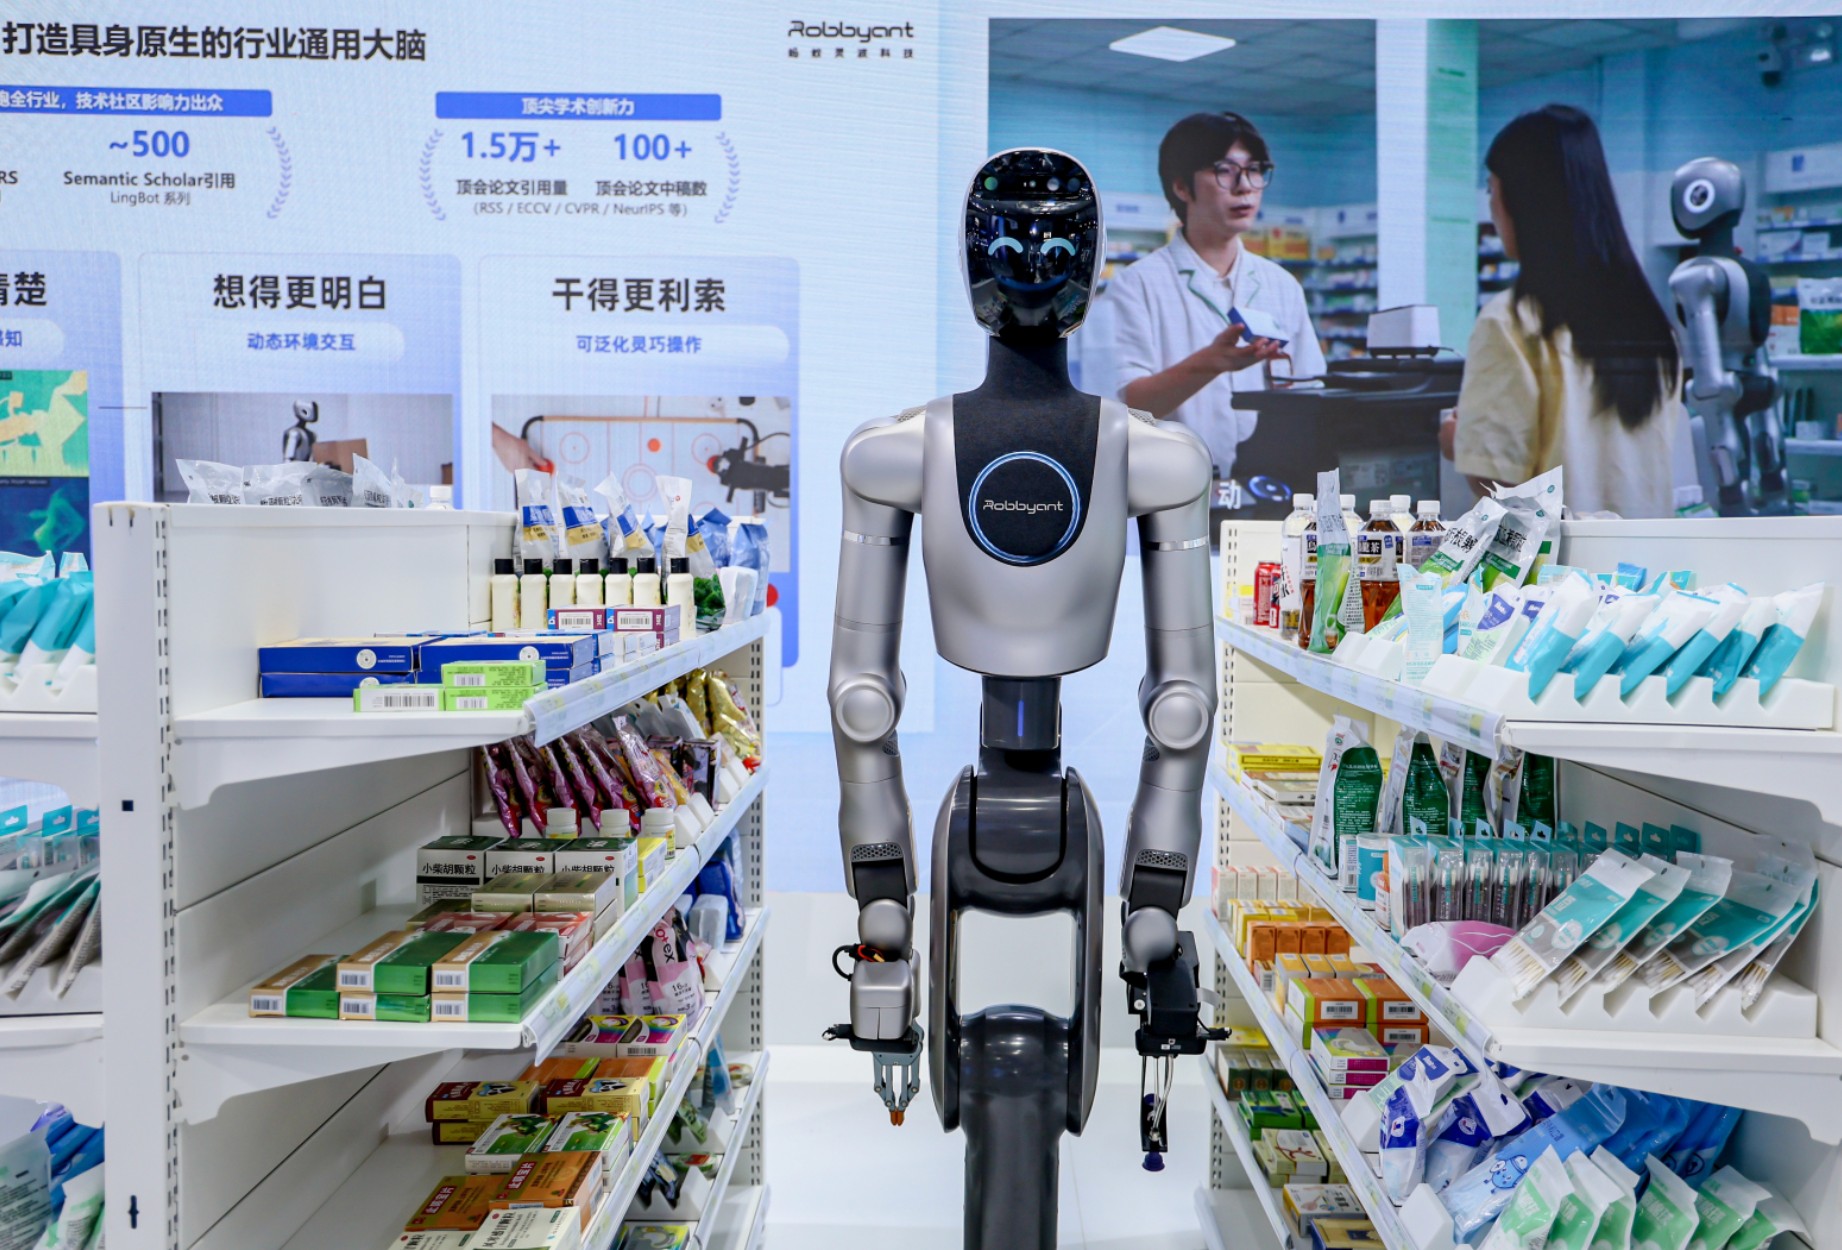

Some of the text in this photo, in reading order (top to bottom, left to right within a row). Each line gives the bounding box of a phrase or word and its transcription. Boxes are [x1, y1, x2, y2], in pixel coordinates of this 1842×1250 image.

[788, 20, 914, 43] Robbyant
[2, 22, 427, 61] 打造具身原生的行业通用大脑
[521, 97, 635, 116] 顶尖学术创新力
[109, 130, 190, 158] ~500
[461, 131, 561, 163] 1.5万+
[613, 133, 692, 161] 100+
[64, 171, 236, 189] Semantic Scholar引用
[456, 179, 568, 196] 顶会论文引用量
[595, 180, 707, 197] 顶会论文中稿数
[110, 191, 191, 206] LingBot 系列
[517, 202, 551, 214] ECCV
[564, 203, 600, 215] CVPR
[613, 203, 665, 215] NeurIPS
[0, 272, 47, 306] 楚
[213, 274, 386, 310] 想得更明白
[552, 277, 726, 313] 干得更利索
[0, 329, 22, 347] 知
[247, 332, 356, 351] 动态环境交互
[575, 335, 702, 354] 可泛化灵巧操作
[1218, 479, 1242, 510] 动
[983, 499, 1064, 515] Robbyant
[422, 862, 476, 875] 小柴胡颗粒
[655, 928, 675, 963] otex
